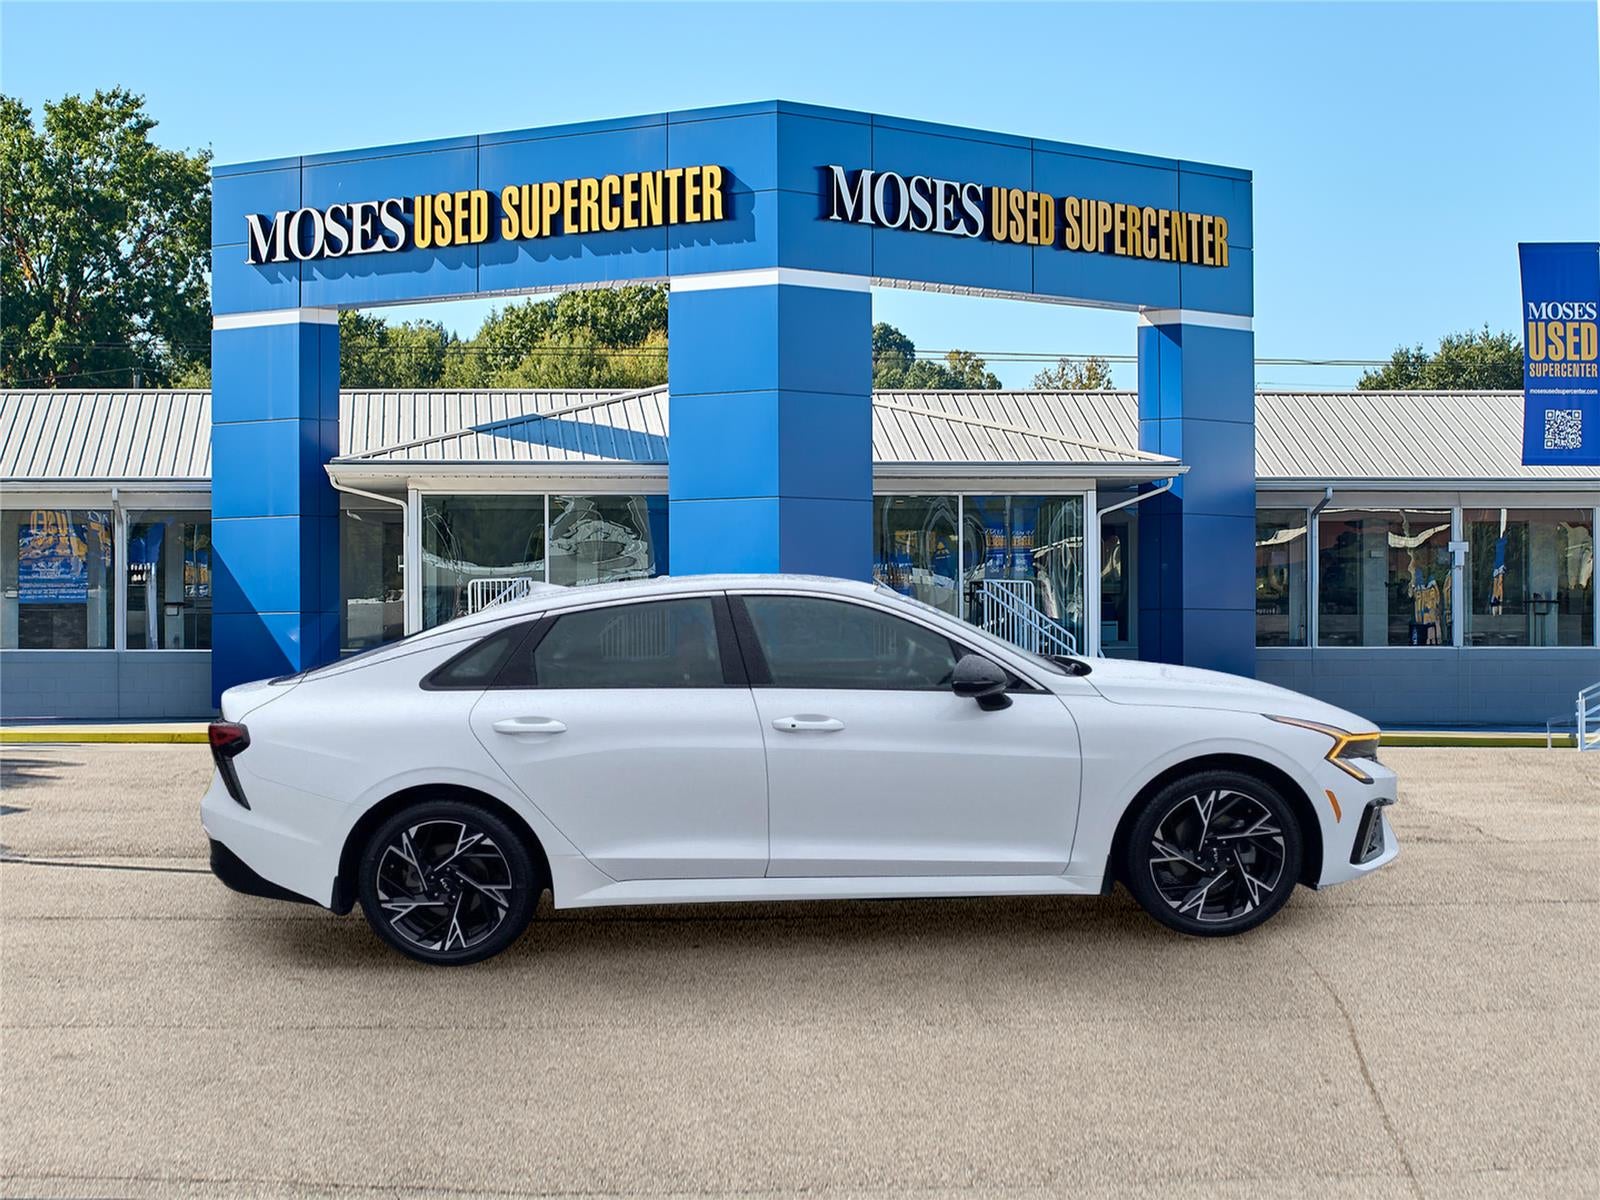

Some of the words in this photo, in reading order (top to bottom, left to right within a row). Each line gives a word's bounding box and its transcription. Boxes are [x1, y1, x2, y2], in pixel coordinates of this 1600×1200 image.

[244, 198, 407, 265] MOSES
[413, 189, 489, 249] USED
[501, 164, 724, 241] SUPERCENTER
[829, 164, 985, 238] MOSES
[991, 186, 1055, 246] USED
[1065, 196, 1229, 267] SUPERCENTER
[1527, 302, 1597, 320] MOSES
[1528, 321, 1598, 361] USED
[1529, 362, 1598, 378] SUPERCENTER
